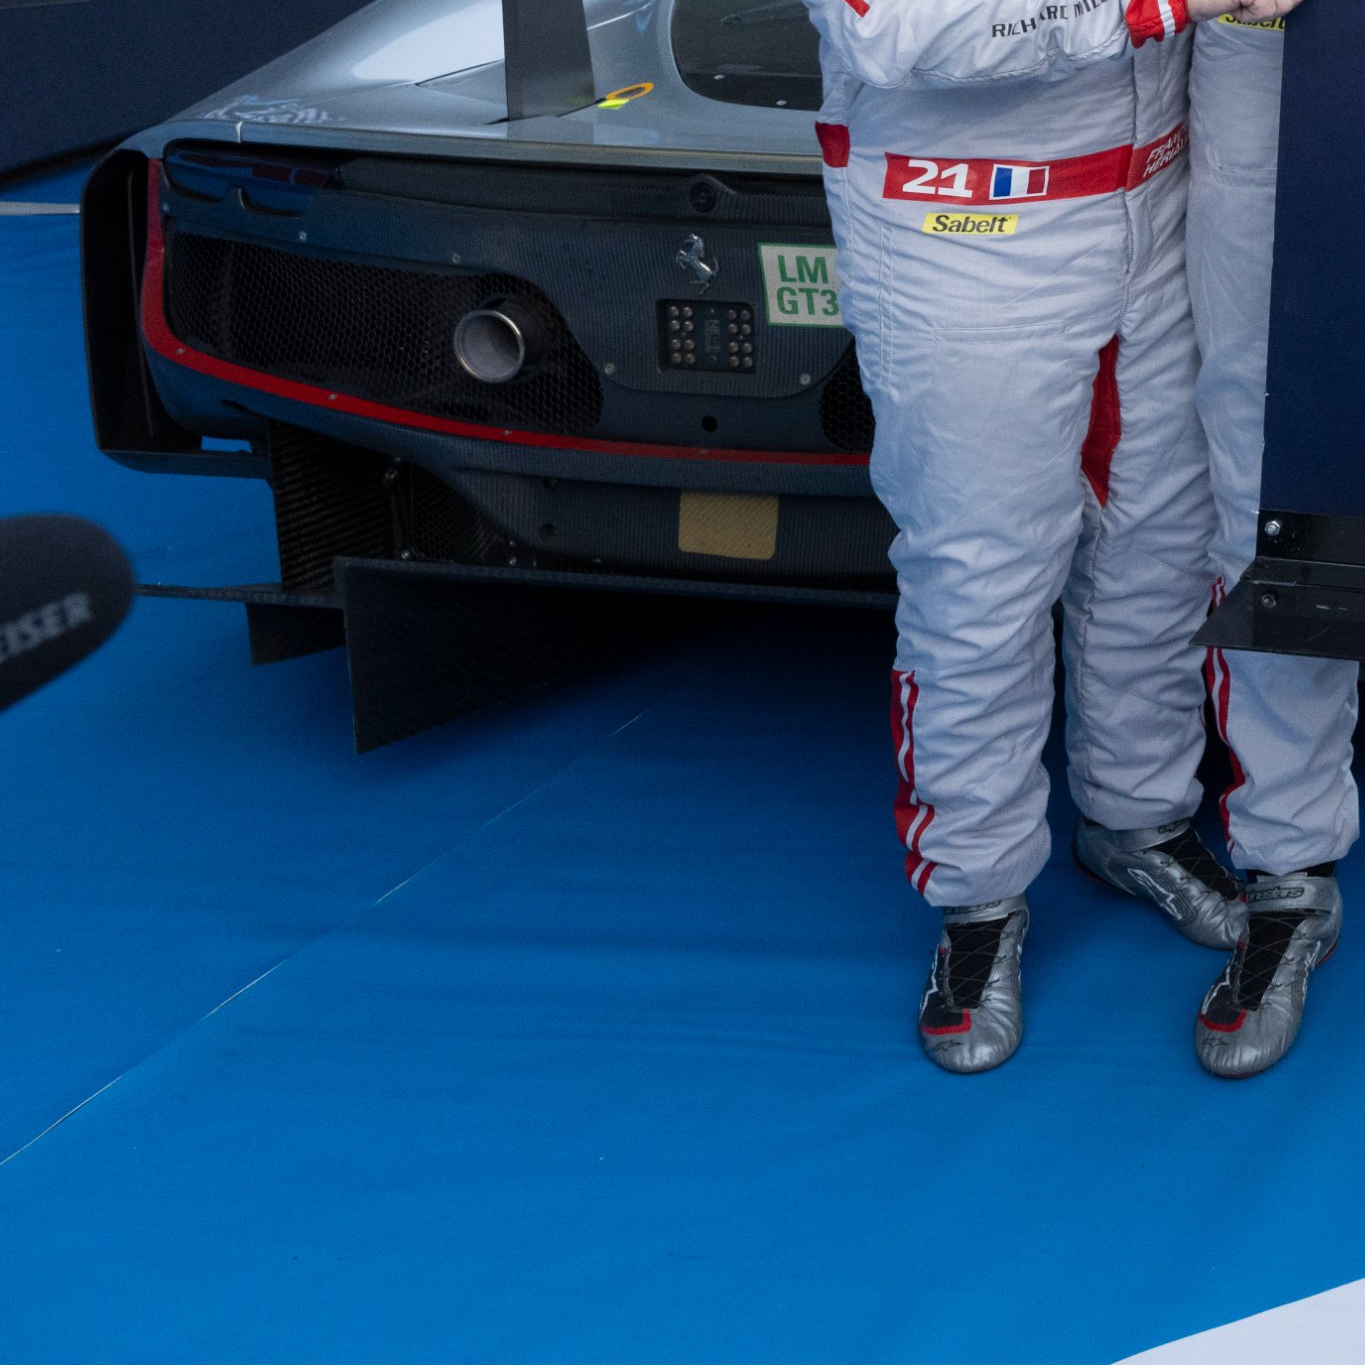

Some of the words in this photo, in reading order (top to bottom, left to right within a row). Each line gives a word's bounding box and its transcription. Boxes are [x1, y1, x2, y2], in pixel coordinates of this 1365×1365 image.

[902, 159, 973, 198] 21
[932, 214, 1008, 234] Sabelt
[777, 255, 829, 284] LM
[776, 286, 840, 316] GT3
